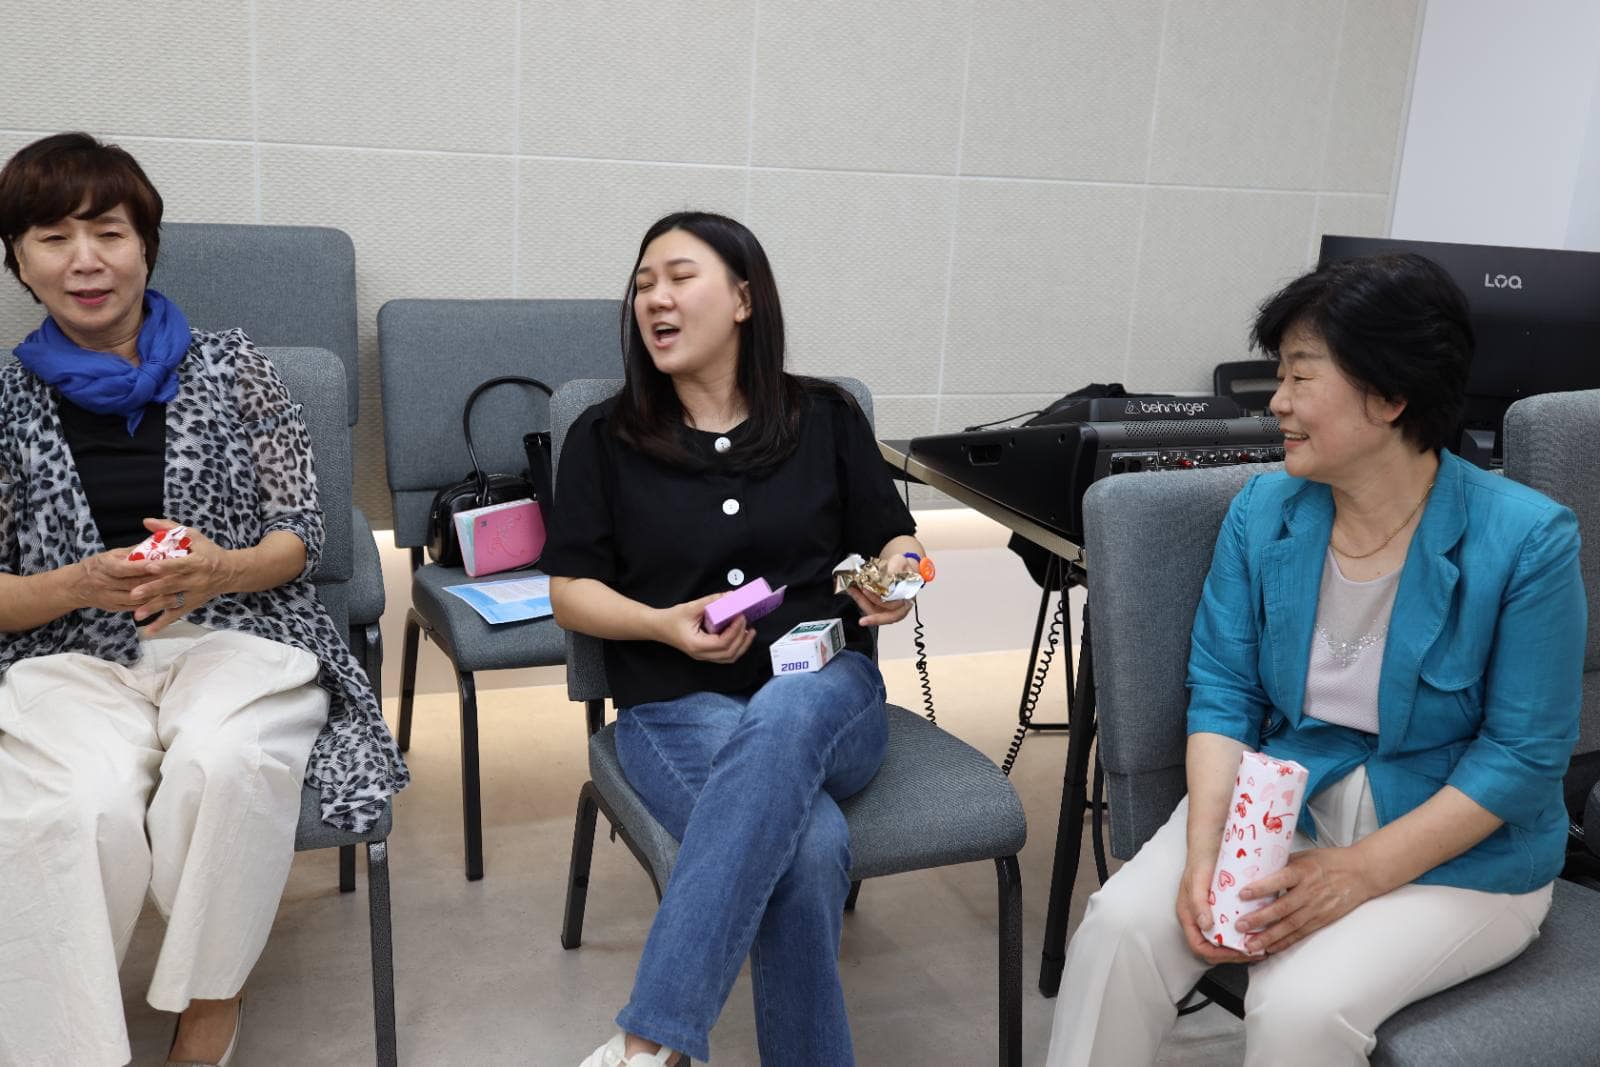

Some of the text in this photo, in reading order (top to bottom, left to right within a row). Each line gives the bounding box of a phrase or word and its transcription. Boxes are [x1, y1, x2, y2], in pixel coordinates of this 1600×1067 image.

[1484, 272, 1523, 290] LOQ
[1140, 400, 1209, 416] behringer
[781, 660, 809, 672] 2080
